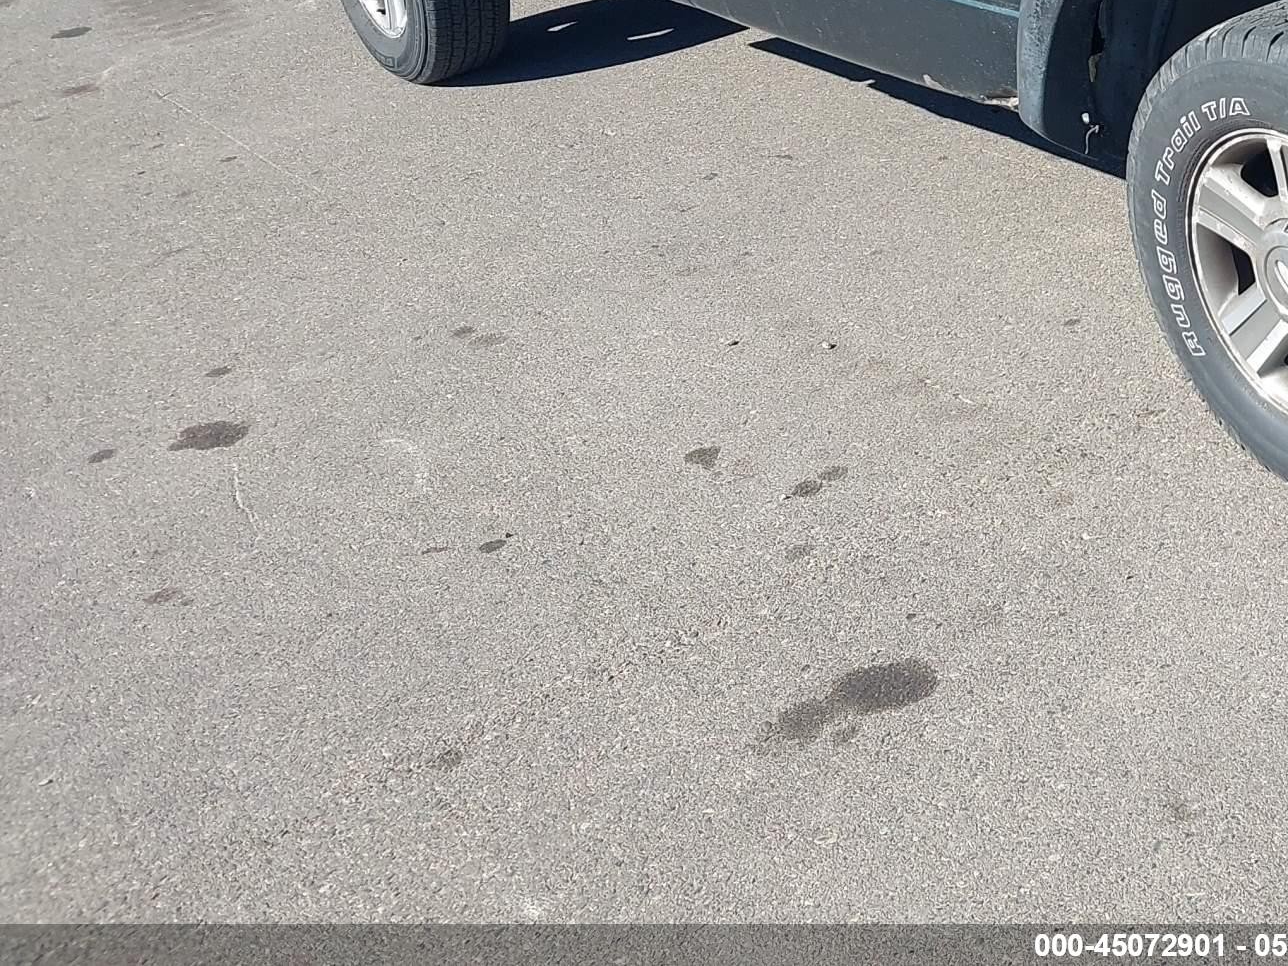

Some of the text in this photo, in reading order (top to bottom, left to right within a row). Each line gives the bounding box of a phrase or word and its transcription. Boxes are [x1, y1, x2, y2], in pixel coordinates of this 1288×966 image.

[1152, 97, 1251, 356] Rugged Trail T/A
